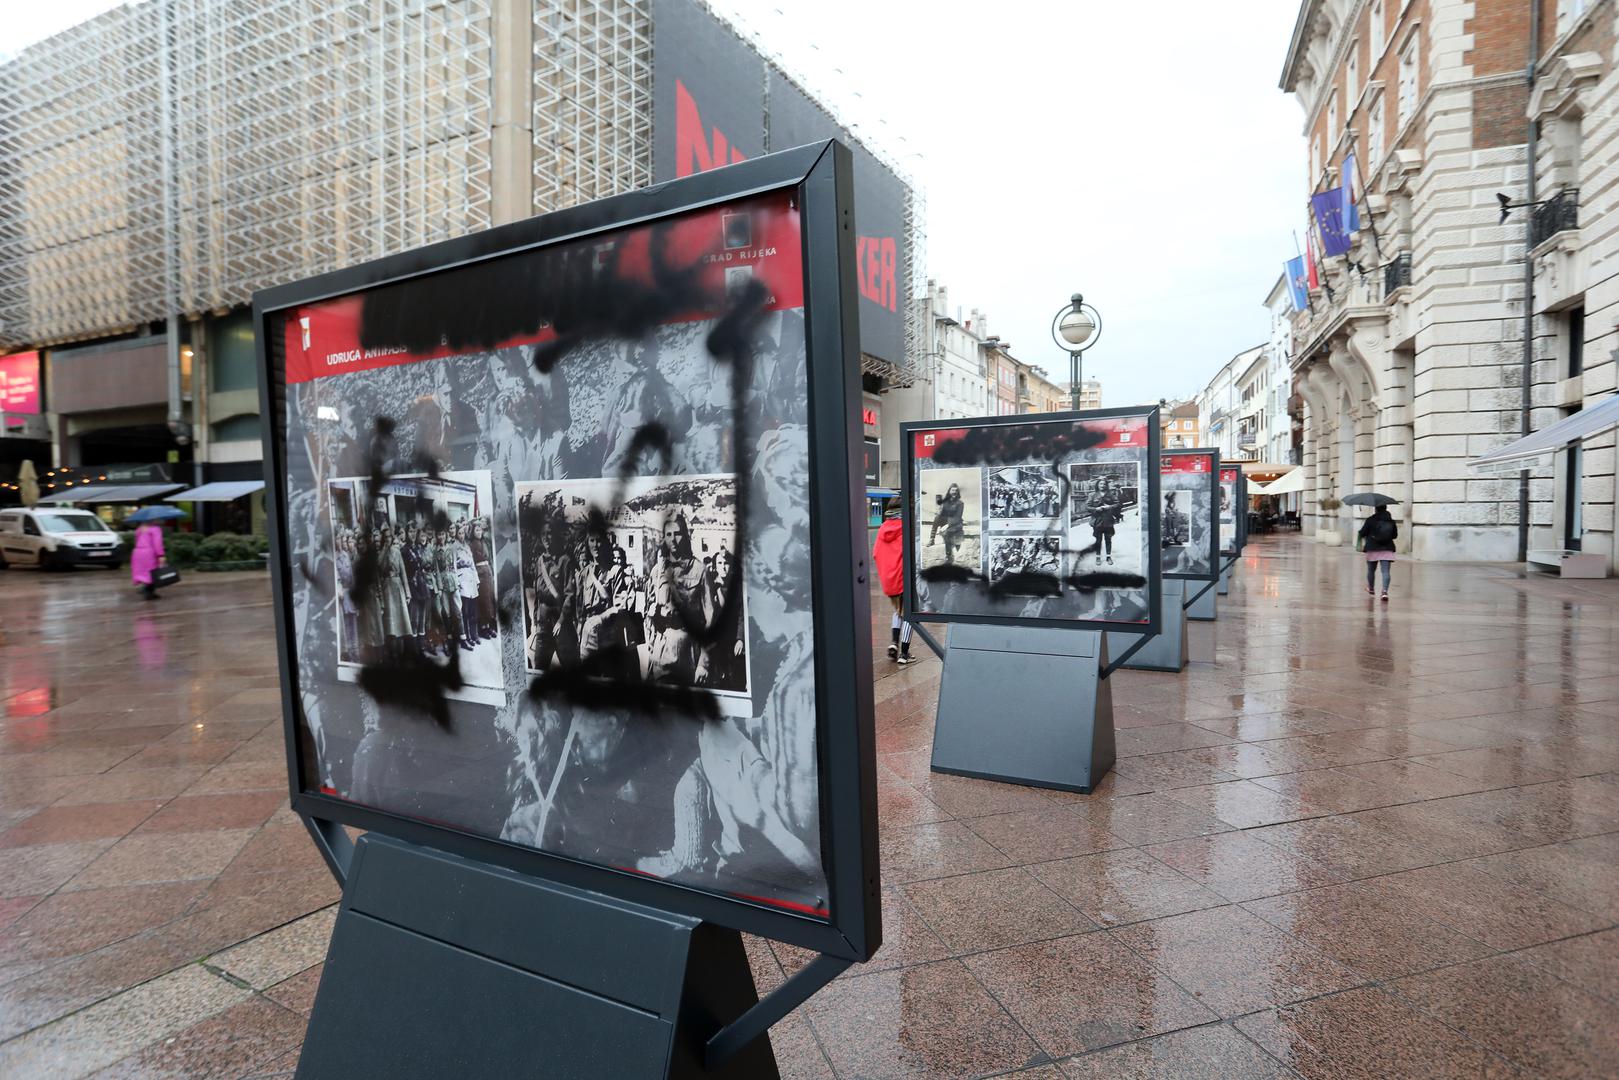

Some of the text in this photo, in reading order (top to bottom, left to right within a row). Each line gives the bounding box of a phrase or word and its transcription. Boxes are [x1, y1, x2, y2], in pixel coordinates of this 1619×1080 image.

[703, 247, 777, 264] GRAD RIJEKA
[326, 349, 361, 366] UDRUGA
